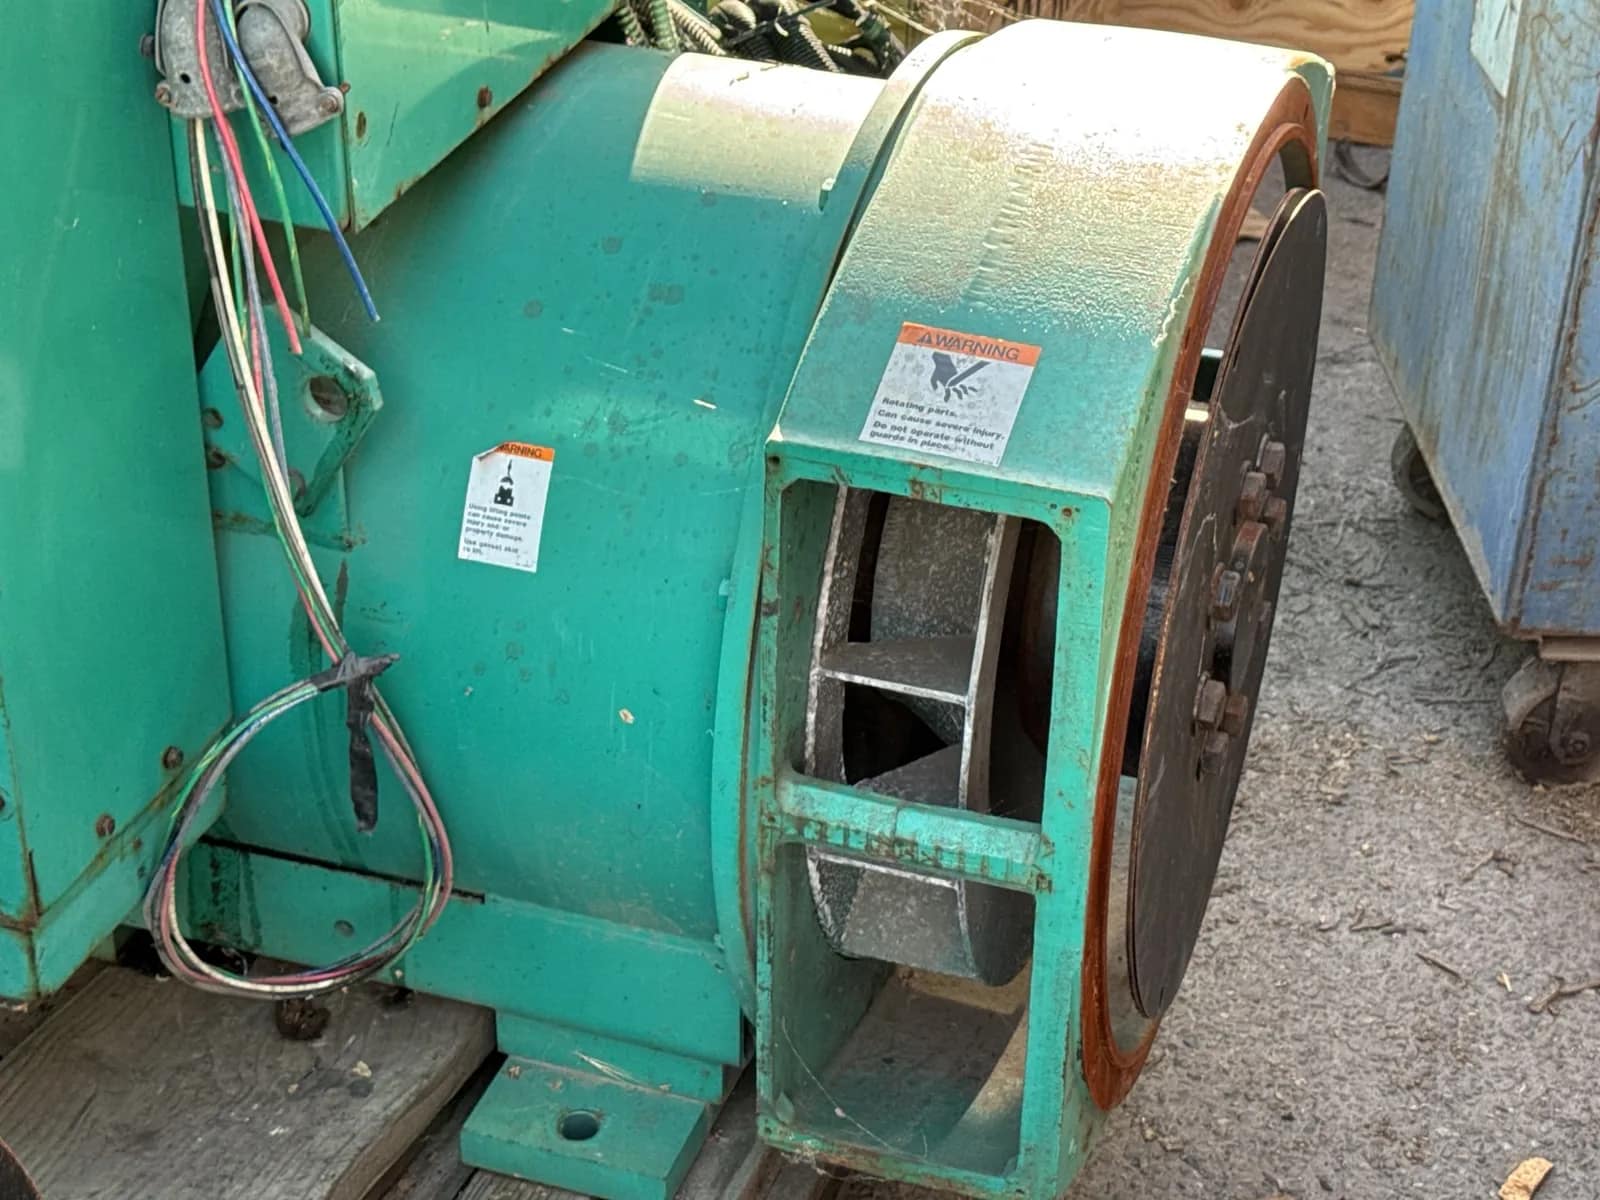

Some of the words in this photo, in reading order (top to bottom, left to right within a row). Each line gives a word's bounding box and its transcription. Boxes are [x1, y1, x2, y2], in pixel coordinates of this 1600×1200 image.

[935, 334, 1020, 361] WARNING
[882, 397, 925, 412] Rotating
[927, 407, 958, 419] parts.
[878, 409, 898, 419] Can
[900, 413, 932, 425] cause
[935, 420, 971, 433] severe
[972, 426, 1006, 441] injury.
[869, 430, 905, 441] guards
[907, 437, 919, 445] in
[873, 420, 888, 429] Do
[890, 424, 908, 433] not
[910, 428, 951, 441] operate
[954, 434, 995, 450] without
[468, 503, 488, 512] Using
[489, 506, 508, 516] lifting
[509, 511, 531, 520] points
[482, 514, 502, 522] cause
[504, 518, 527, 528] severe
[465, 526, 494, 538] property
[464, 537, 477, 546] Use
